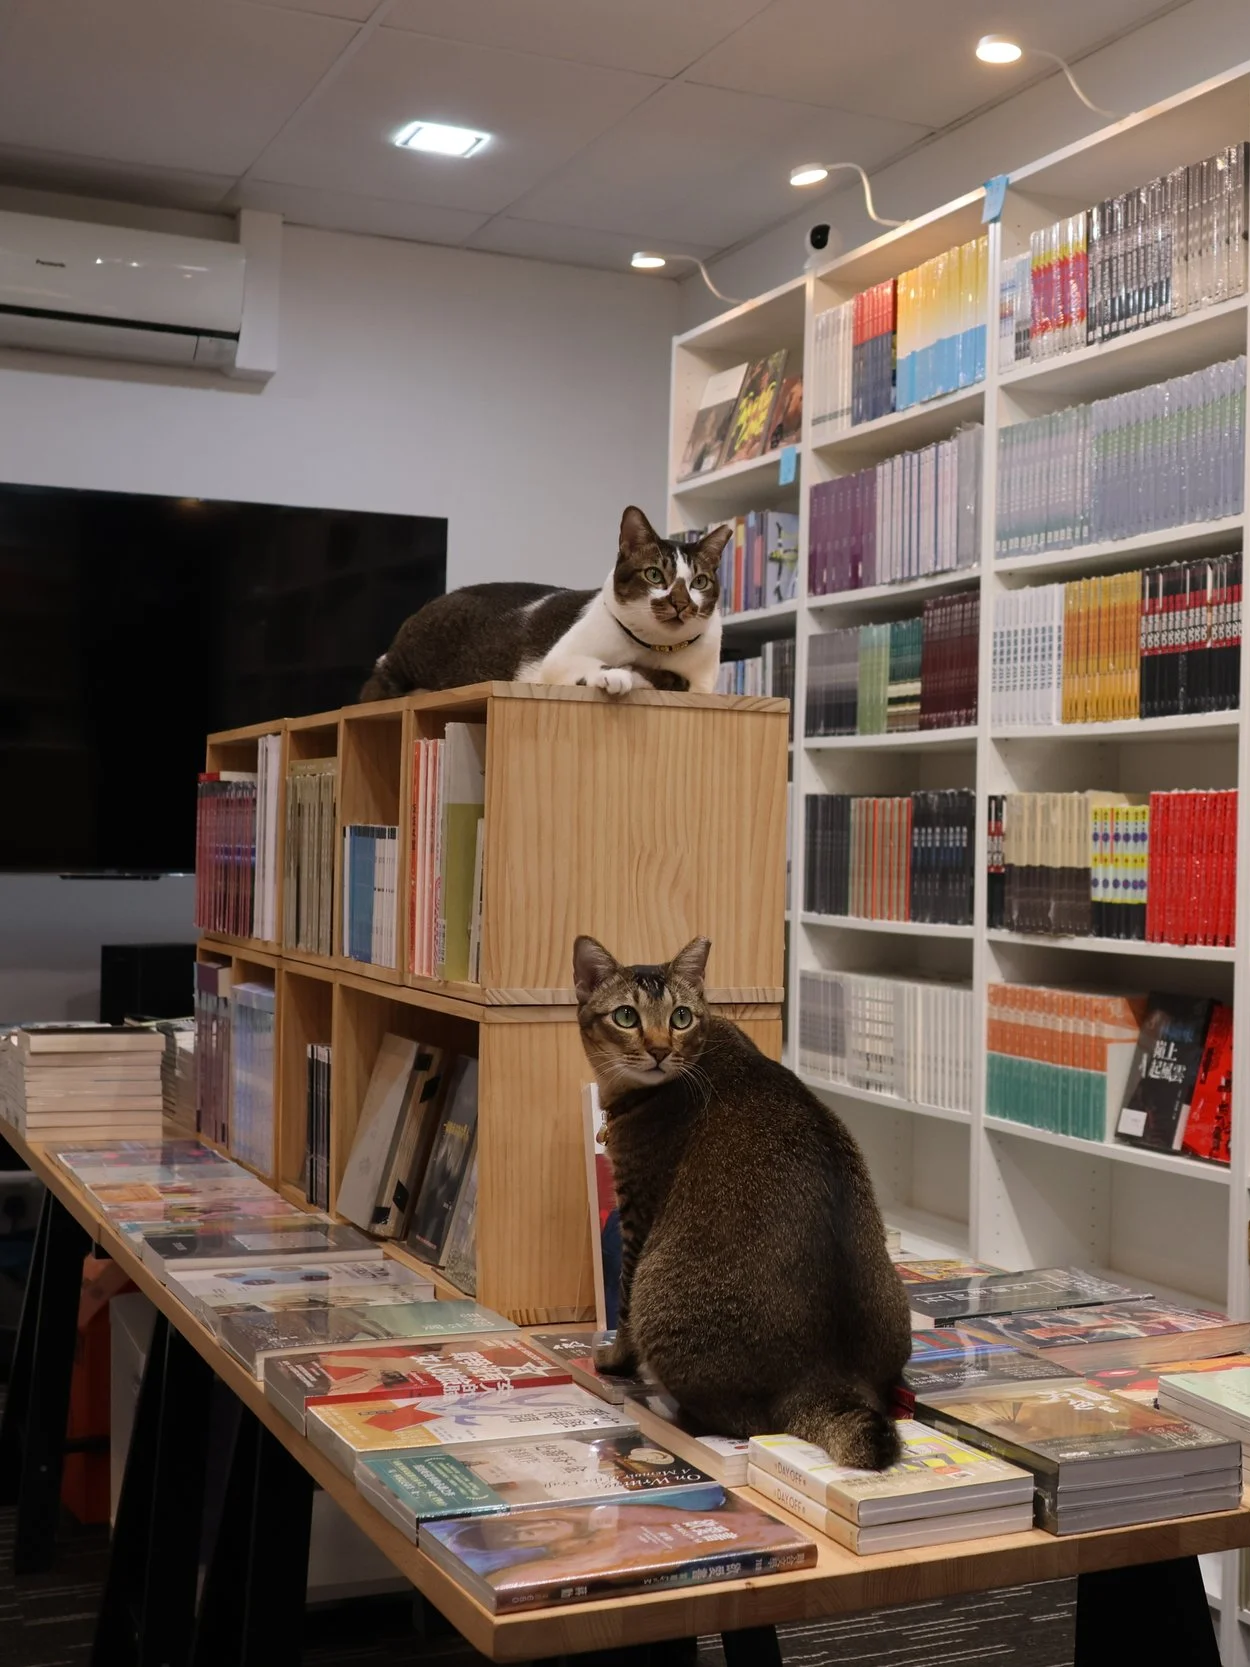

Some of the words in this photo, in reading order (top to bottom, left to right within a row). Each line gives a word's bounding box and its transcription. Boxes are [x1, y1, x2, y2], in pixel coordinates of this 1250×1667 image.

[1149, 1061, 1187, 1084] 起風雲
[624, 1470, 676, 1479] Memoir
[674, 1474, 701, 1482] On
